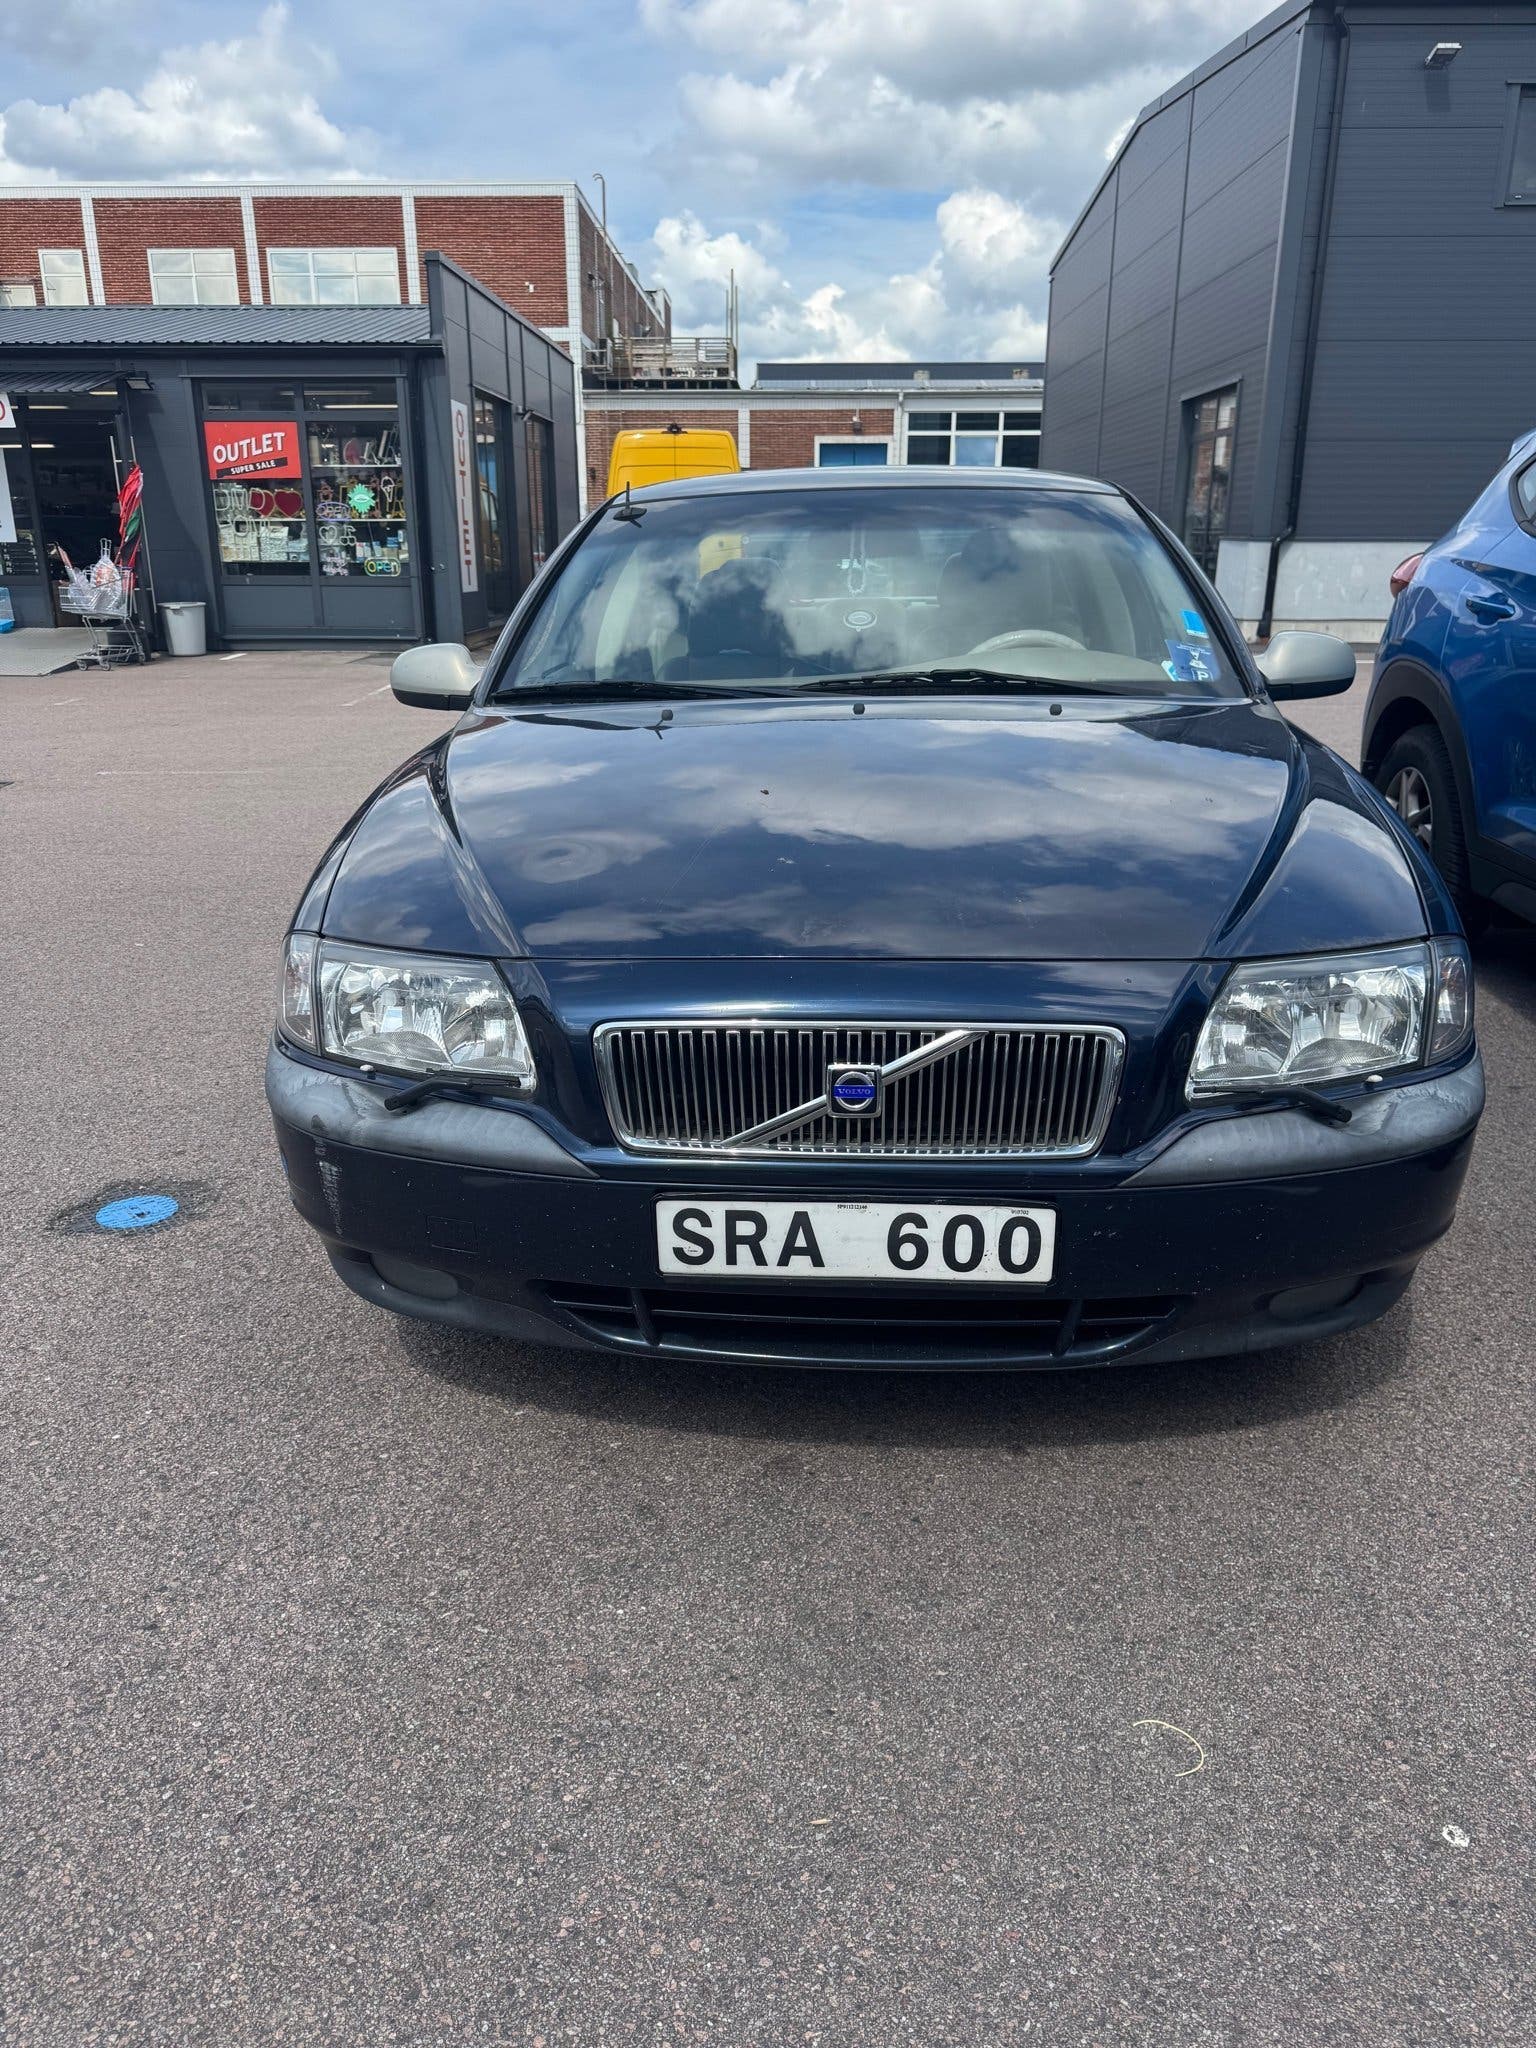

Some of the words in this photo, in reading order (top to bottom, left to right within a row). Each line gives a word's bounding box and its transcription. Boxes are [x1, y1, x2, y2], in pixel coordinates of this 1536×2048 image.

[212, 431, 286, 464] OUTLET
[230, 463, 255, 475] SUPER
[256, 459, 277, 471] SALE
[455, 409, 472, 586] OUTLET
[672, 1207, 825, 1268] SRA
[887, 1212, 1042, 1274] 600
